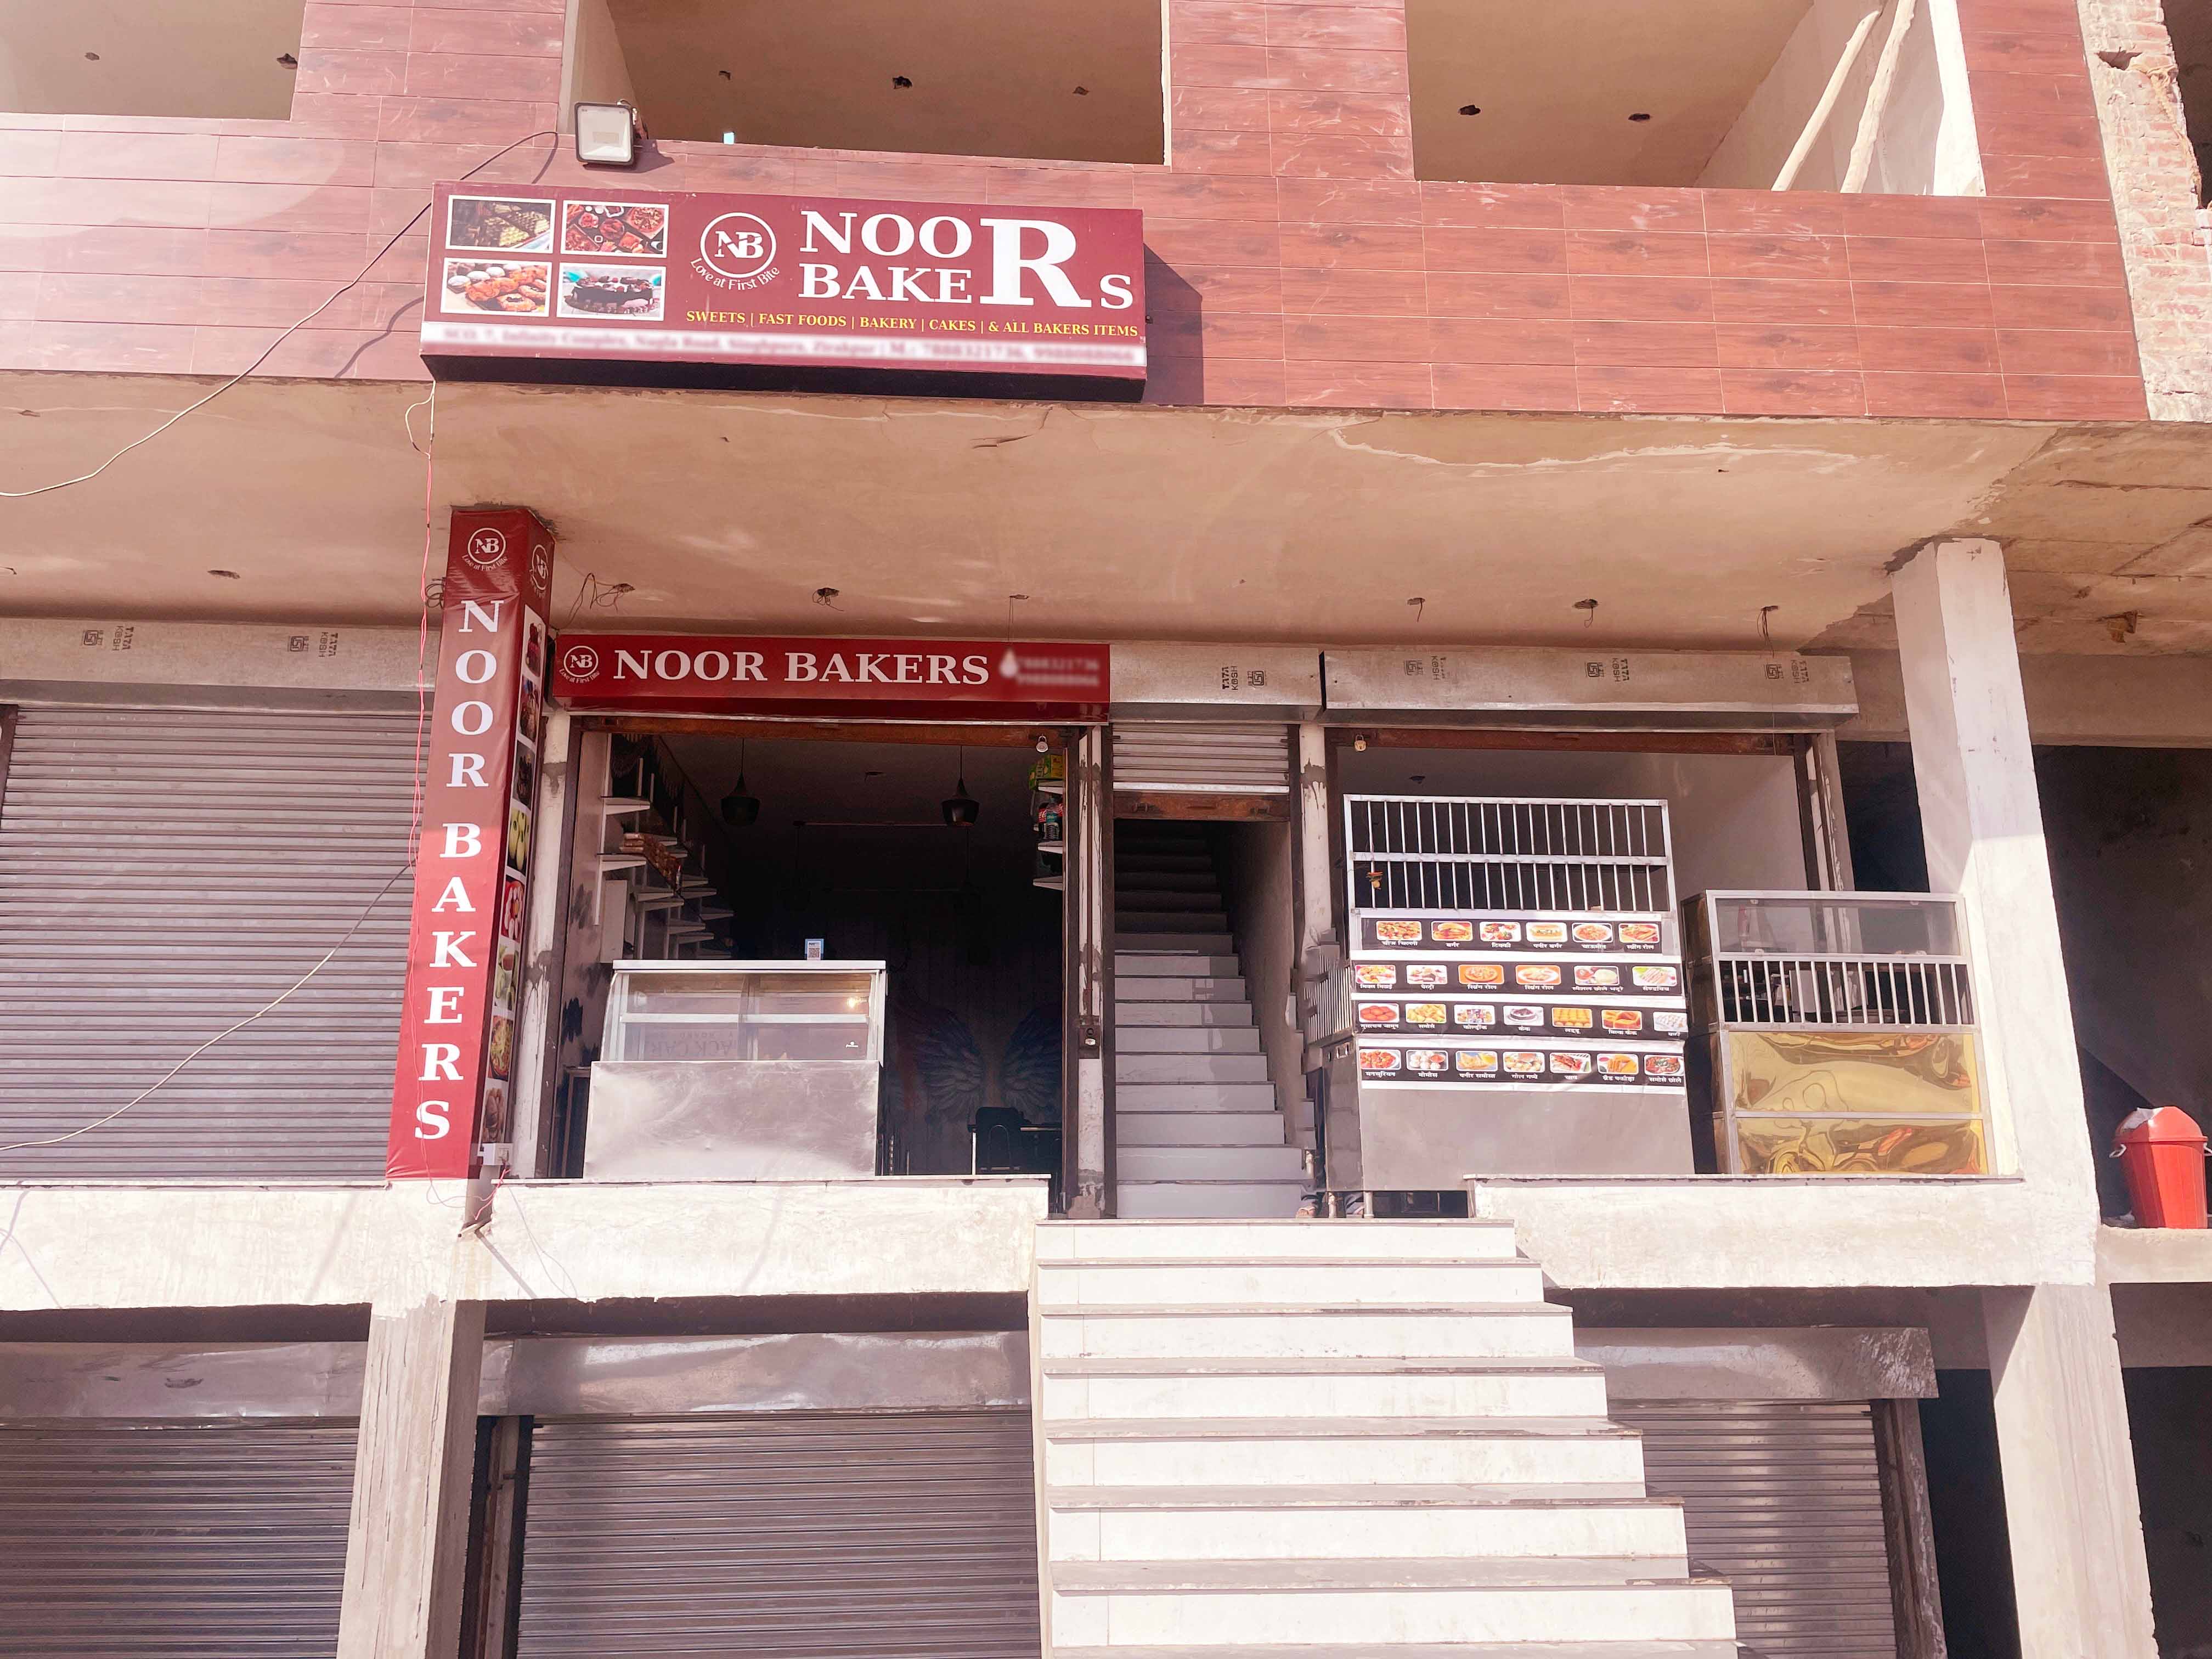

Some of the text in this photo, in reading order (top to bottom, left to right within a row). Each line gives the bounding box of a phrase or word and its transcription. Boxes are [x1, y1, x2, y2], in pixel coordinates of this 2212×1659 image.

[714, 230, 764, 259] NB
[690, 258, 780, 290] Love at First Bite
[686, 311, 746, 323] SWEETS
[759, 313, 794, 325] FAST
[798, 314, 847, 327] FOODS
[860, 316, 917, 329] BAKERY
[929, 319, 976, 331] CAKES
[1002, 321, 1029, 334] ALL
[1033, 322, 1090, 335] BAKERS
[1093, 324, 1138, 337] ITEMS
[475, 538, 500, 554] NB
[570, 654, 592, 668] NB
[613, 650, 766, 681] NOOR
[783, 651, 989, 686] BAKERS
[446, 599, 505, 788] NOOR
[414, 822, 482, 1141] BAKERS
